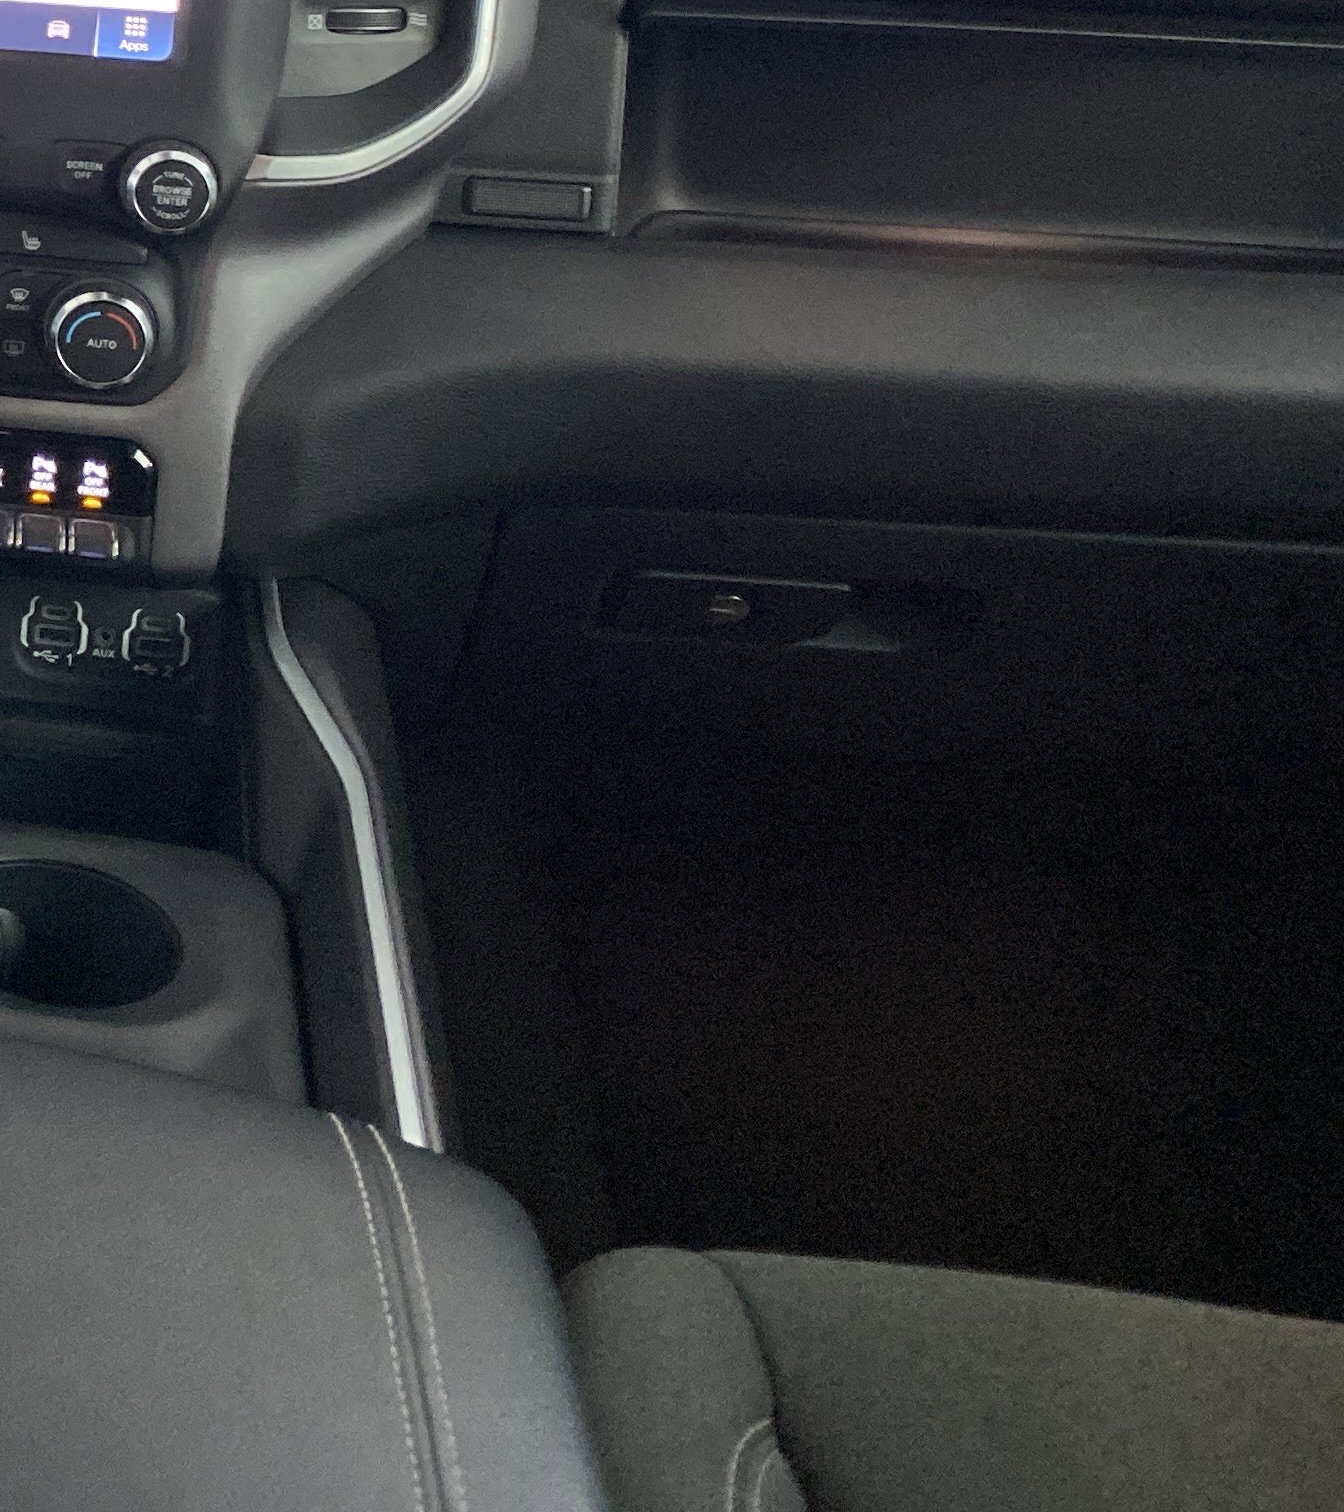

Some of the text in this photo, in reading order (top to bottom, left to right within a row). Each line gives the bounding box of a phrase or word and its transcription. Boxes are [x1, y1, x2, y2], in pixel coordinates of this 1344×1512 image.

[119, 39, 149, 53] Apps
[67, 161, 103, 171] SCREEN
[75, 171, 92, 179] OFF
[153, 185, 192, 196] BROWSE
[157, 196, 188, 206] ENTER
[86, 338, 117, 350] AUTO
[77, 486, 109, 497] FRONT
[92, 648, 115, 658] AUX
